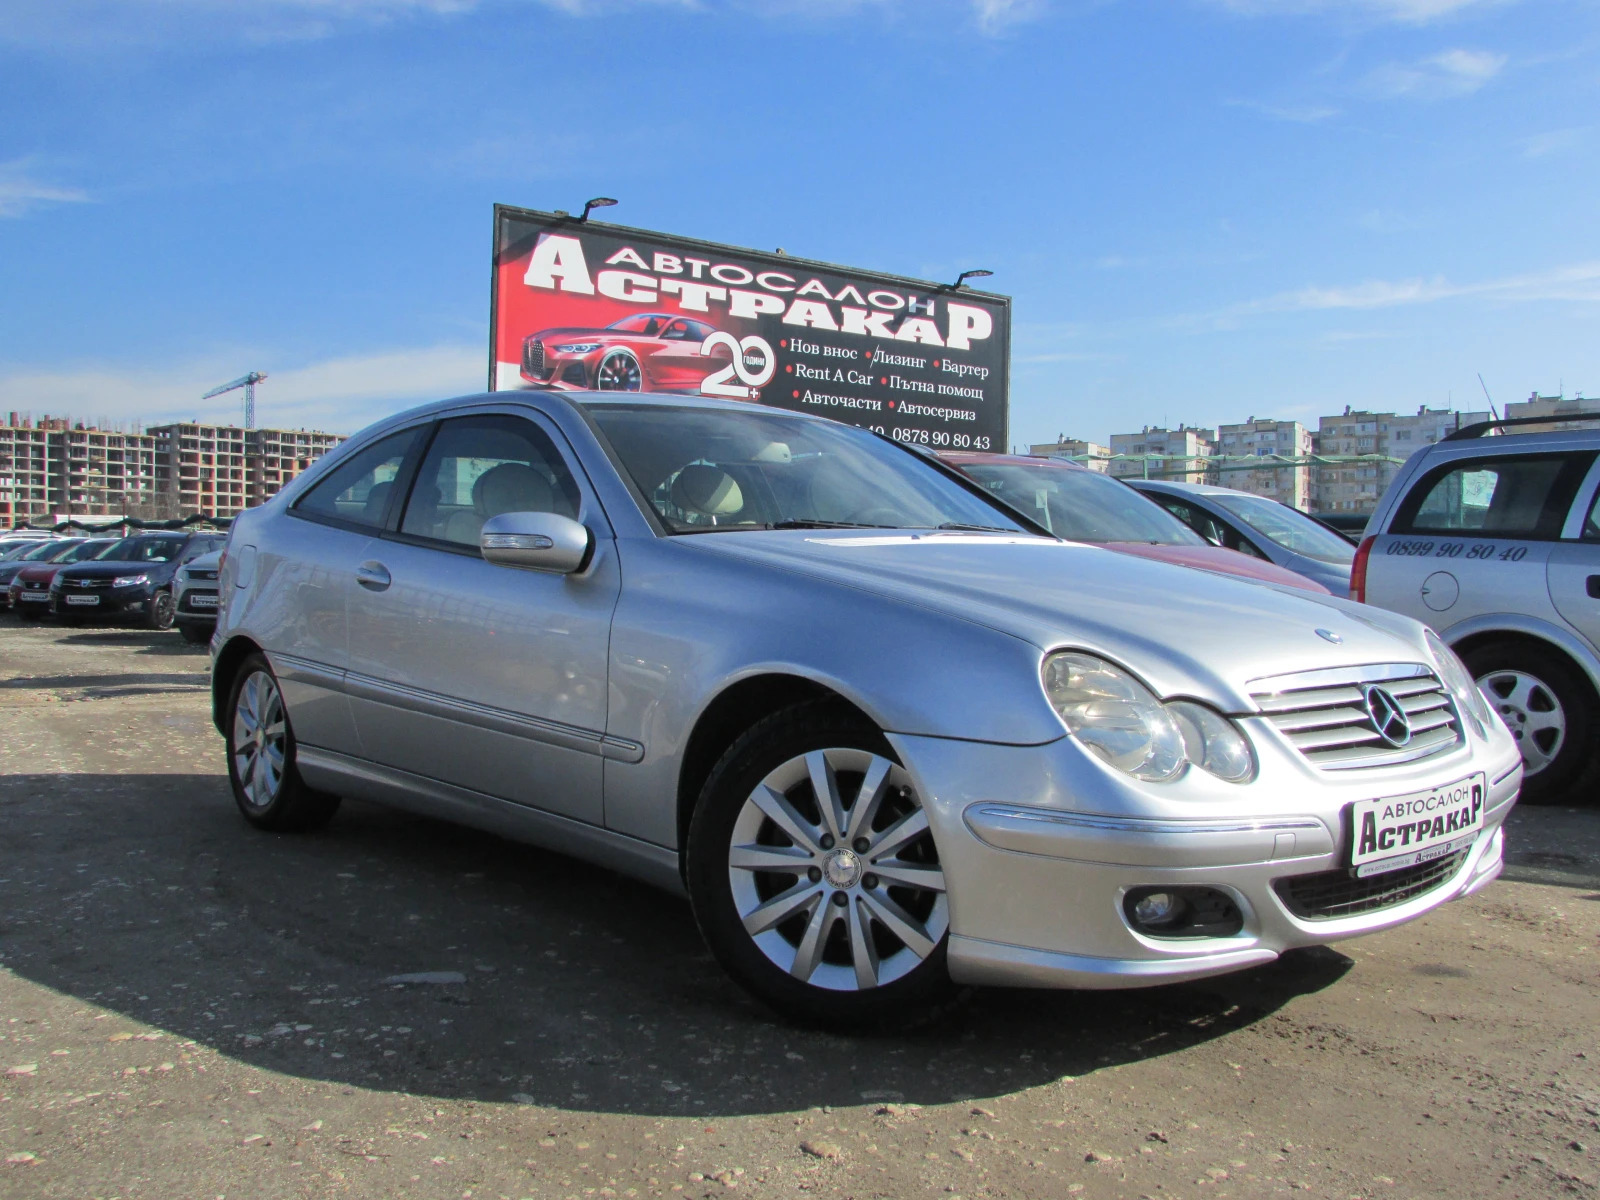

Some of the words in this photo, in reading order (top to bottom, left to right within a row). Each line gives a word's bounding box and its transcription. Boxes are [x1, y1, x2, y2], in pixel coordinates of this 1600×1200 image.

[605, 247, 935, 315] АВТОСАЛОН
[790, 338, 820, 354] Нов
[823, 344, 858, 359] внос
[873, 350, 927, 369] Лизинг
[942, 358, 989, 380] Бартер
[795, 364, 830, 381] Rent
[833, 368, 846, 382] A
[847, 370, 873, 386] Car
[889, 375, 935, 393] Пътна
[937, 383, 984, 401] помощ
[802, 389, 882, 411] Авточасти
[897, 400, 976, 422] Автосервиз
[892, 427, 929, 444] 0878
[932, 431, 949, 446] 90
[953, 434, 970, 448] 80
[973, 436, 990, 450] 43
[1387, 540, 1435, 557] 0899
[1435, 542, 1464, 558] 90
[1465, 544, 1496, 560] 80
[1498, 546, 1528, 562] 40
[1382, 787, 1469, 820] АВТОСАЛОН
